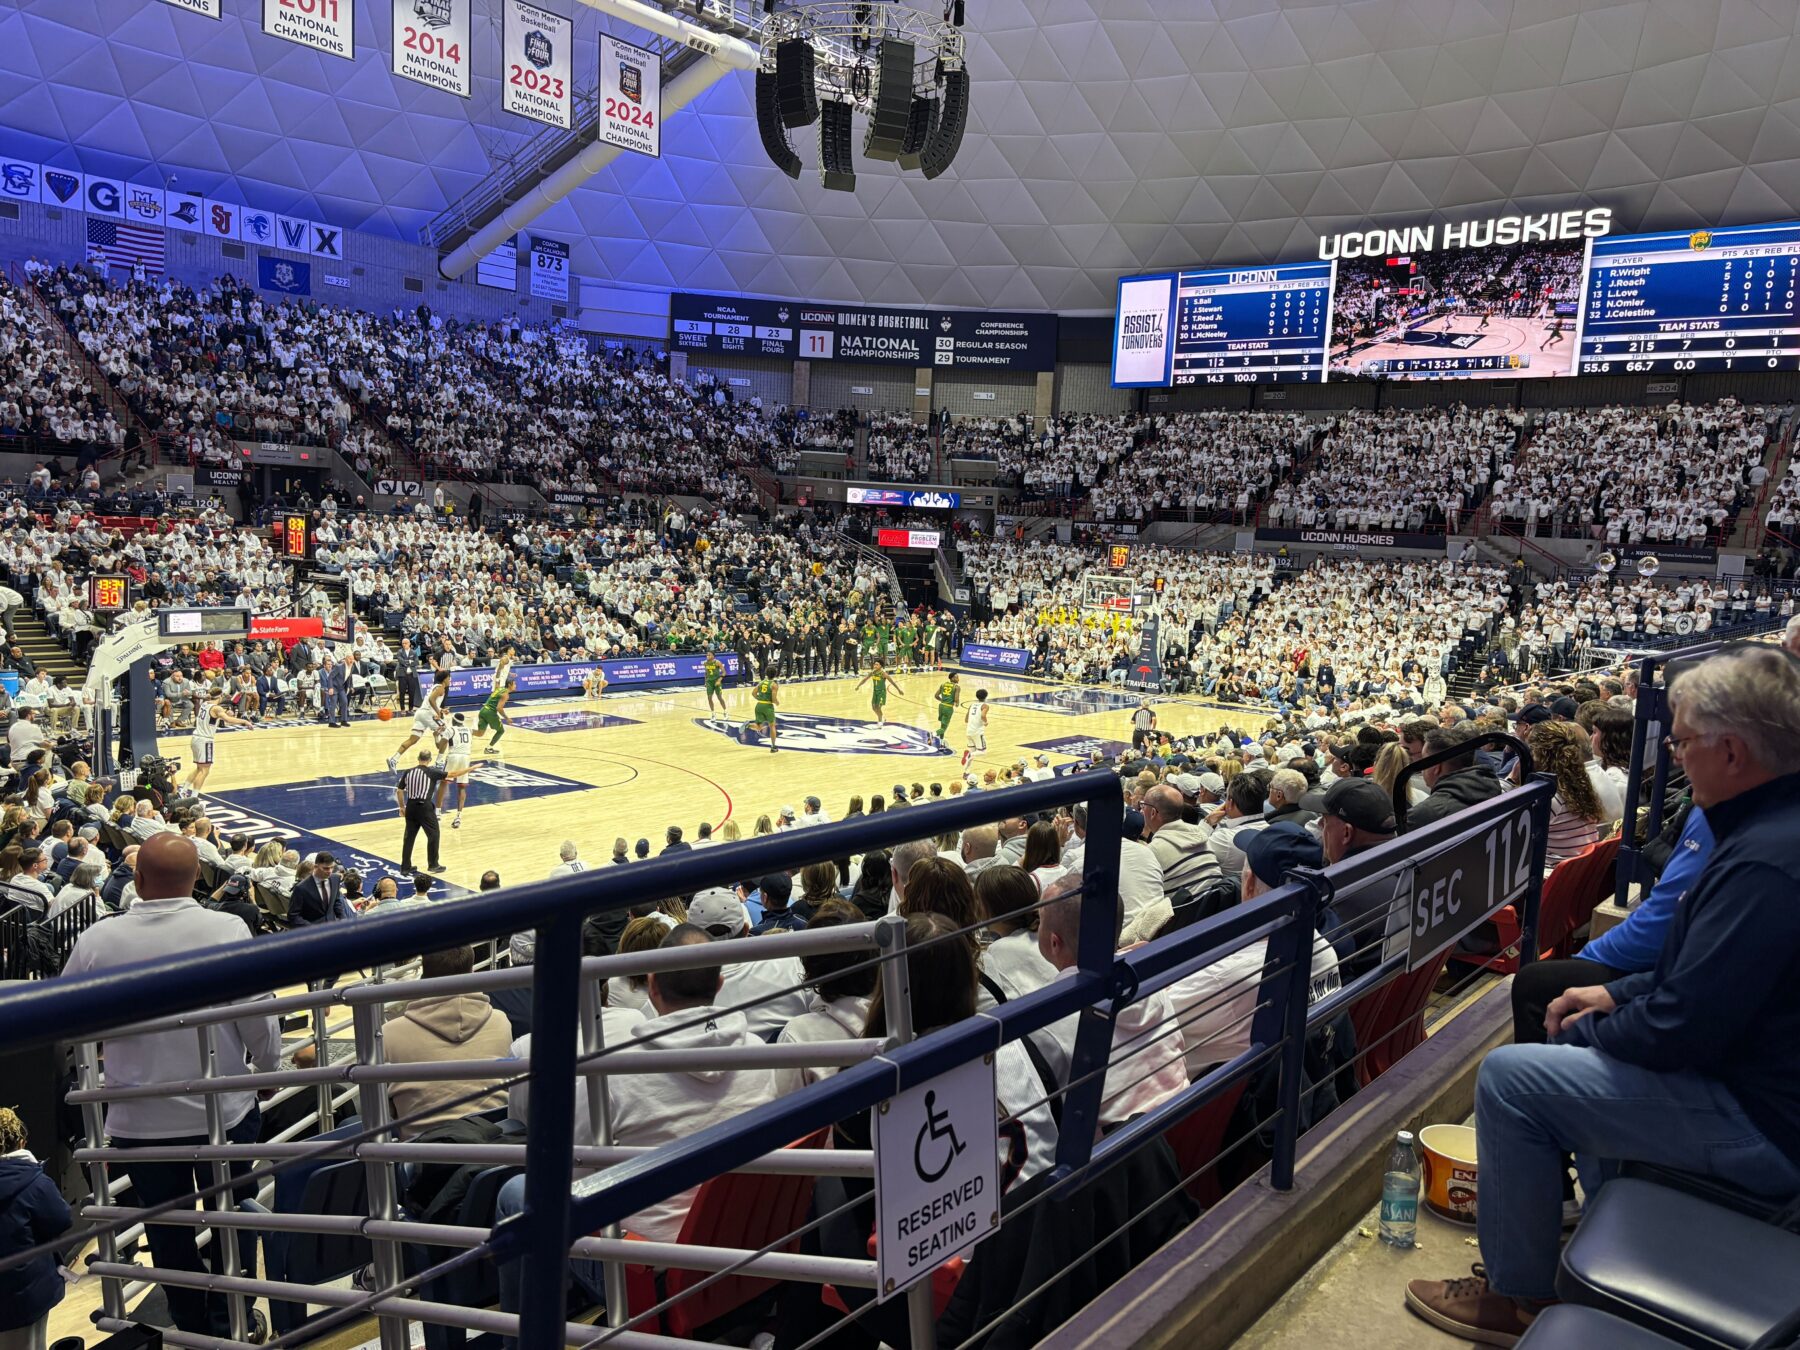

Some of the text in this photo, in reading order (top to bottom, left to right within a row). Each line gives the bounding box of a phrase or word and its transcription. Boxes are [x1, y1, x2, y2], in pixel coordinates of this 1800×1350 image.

[516, 3, 560, 25] UConn Men's
[280, 10, 339, 37] NATIONAL
[521, 15, 556, 33] Basketball
[274, 24, 344, 52] CHAMPIONS
[403, 26, 460, 64] 2014
[611, 40, 650, 60] UConn Men's
[406, 52, 458, 78] NATIONAL
[615, 51, 646, 67] Basketball
[402, 65, 462, 92] CHAMPIONS
[510, 65, 564, 99] 2023
[515, 90, 561, 112] NATIONAL
[511, 101, 564, 126] CHAMPIONS
[605, 98, 653, 129] 2024
[609, 122, 649, 141] NATIONAL
[606, 132, 653, 153] CHAMPIONS
[88, 182, 119, 212] G
[281, 220, 307, 248] V
[316, 228, 338, 255] X
[1319, 208, 1612, 260] UCONN HUSKIES
[543, 248, 566, 256] CALHOUN
[538, 255, 562, 271] 873
[1612, 257, 1643, 265] PLAYER
[1229, 270, 1277, 284] UCONN
[1608, 278, 1645, 288] J.Roach
[1745, 271, 1753, 279] 0
[1767, 270, 1774, 278] 0
[1610, 267, 1650, 278] R.Wright
[1608, 289, 1638, 298] L.Love
[1744, 282, 1751, 290] 0
[1607, 299, 1644, 308] N.Omier
[1786, 290, 1794, 298] 0
[704, 312, 749, 322] TOURNAMENT
[1605, 309, 1655, 318] J.Celestine
[1741, 303, 1749, 311] 0
[1785, 301, 1793, 310] 0
[688, 323, 699, 331] 31
[728, 326, 740, 334] 28
[800, 312, 929, 330] UCONN WOMEN'S BASKETBALL
[1124, 314, 1157, 334] ASSIST
[1659, 322, 1720, 331] TEAM STATS
[810, 336, 824, 352] 11
[841, 336, 919, 351] NATIONAL
[938, 340, 951, 348] 30
[1122, 334, 1163, 350] TURNOVERS
[1595, 340, 1735, 353] 2 7 0
[840, 348, 919, 360] CHAMPIONSHIPS
[937, 354, 950, 362] 29
[1397, 359, 1492, 370] 6 13:34 14
[1584, 358, 1777, 373] 55.6 66.7 0.0 0
[1234, 374, 1257, 382] 100.0
[210, 472, 242, 480] UCONN
[555, 494, 584, 504] DUNKIN'
[289, 530, 303, 553] 30
[1301, 532, 1394, 545] UCONN HUSKIES
[1112, 555, 1125, 566] 30
[100, 592, 119, 605] 30
[116, 643, 142, 662] SPALDING
[943, 687, 952, 695] 32
[1127, 680, 1159, 689] TRAVELERS
[459, 733, 469, 743] 10
[1415, 809, 1531, 937] SEC 112
[1314, 980, 1326, 998] for
[898, 1176, 984, 1240] RESERVED
[908, 1212, 976, 1267] SEATING
